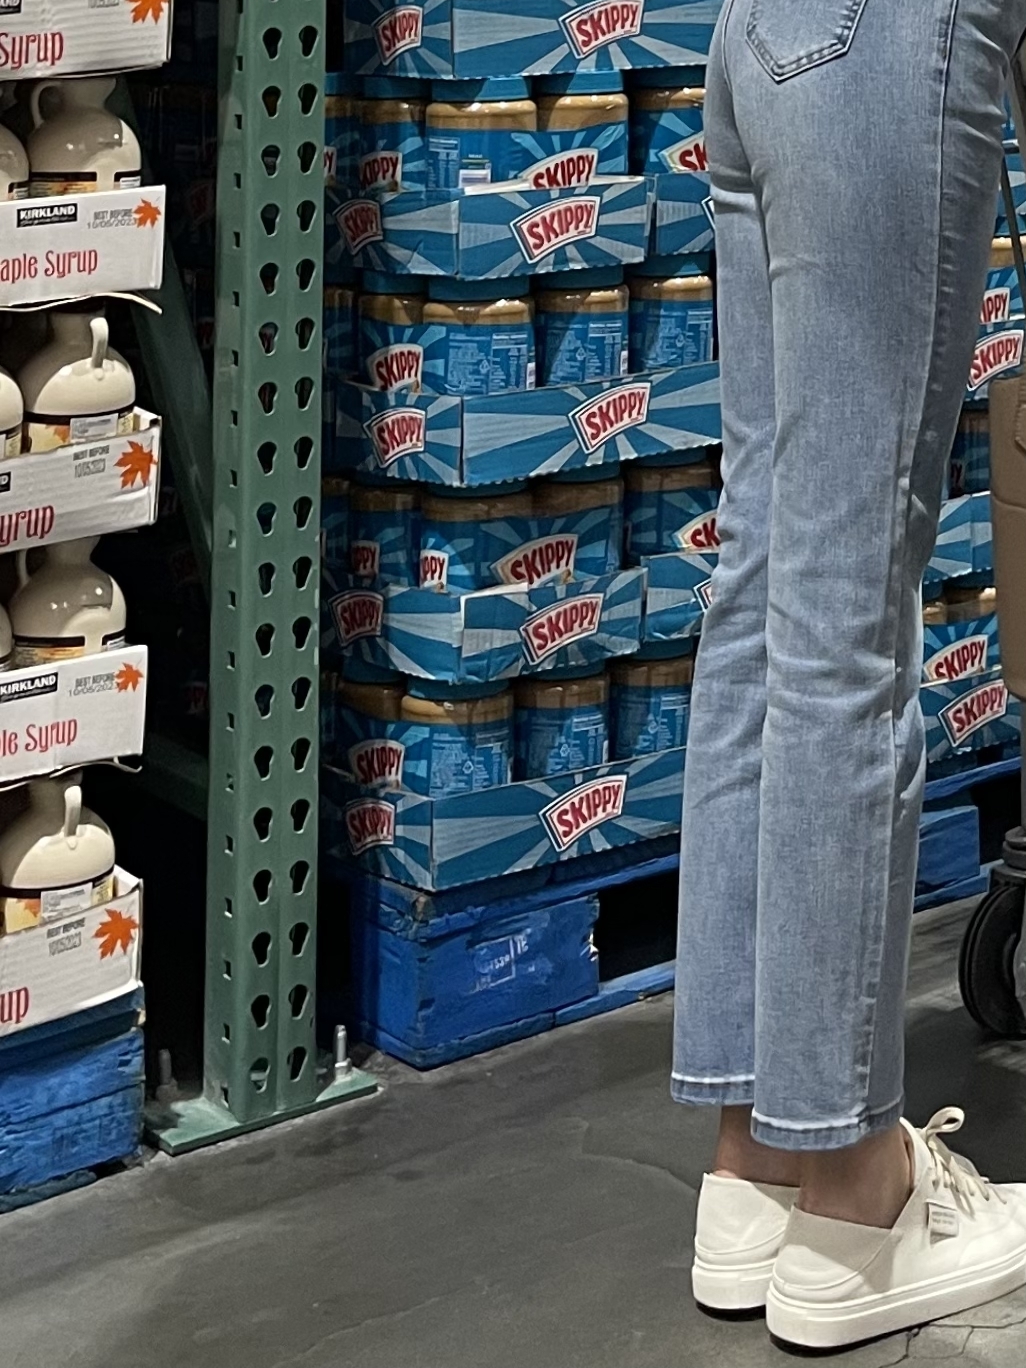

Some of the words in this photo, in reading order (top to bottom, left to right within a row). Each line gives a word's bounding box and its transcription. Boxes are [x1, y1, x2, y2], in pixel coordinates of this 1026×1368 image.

[381, 12, 419, 52] SKIPPY
[575, 3, 641, 48] SKIPPY
[0, 31, 64, 70] Syrup
[533, 152, 594, 189] SKIPPY
[19, 206, 75, 220] KIRKLAND
[344, 203, 380, 242] SKIPPY
[526, 202, 594, 250] SKIPPY
[44, 249, 98, 279] Syrup
[376, 349, 421, 390] SKIPPY
[973, 335, 1022, 384] SKIPPY
[584, 389, 647, 441] SKIPPY
[374, 416, 422, 455] SKIPPY
[510, 539, 574, 585] SKIPPY
[340, 598, 381, 636] SKIPPY
[531, 600, 599, 651] SKIPPY
[935, 640, 986, 679] SKIPPY
[0, 674, 56, 696] KIRKLAND
[953, 683, 1007, 734] SKIPPY
[25, 718, 78, 752] Syrup
[357, 743, 402, 784] SKIPPY
[348, 807, 393, 845] SKIPPY
[556, 783, 622, 838] SKIPPY
